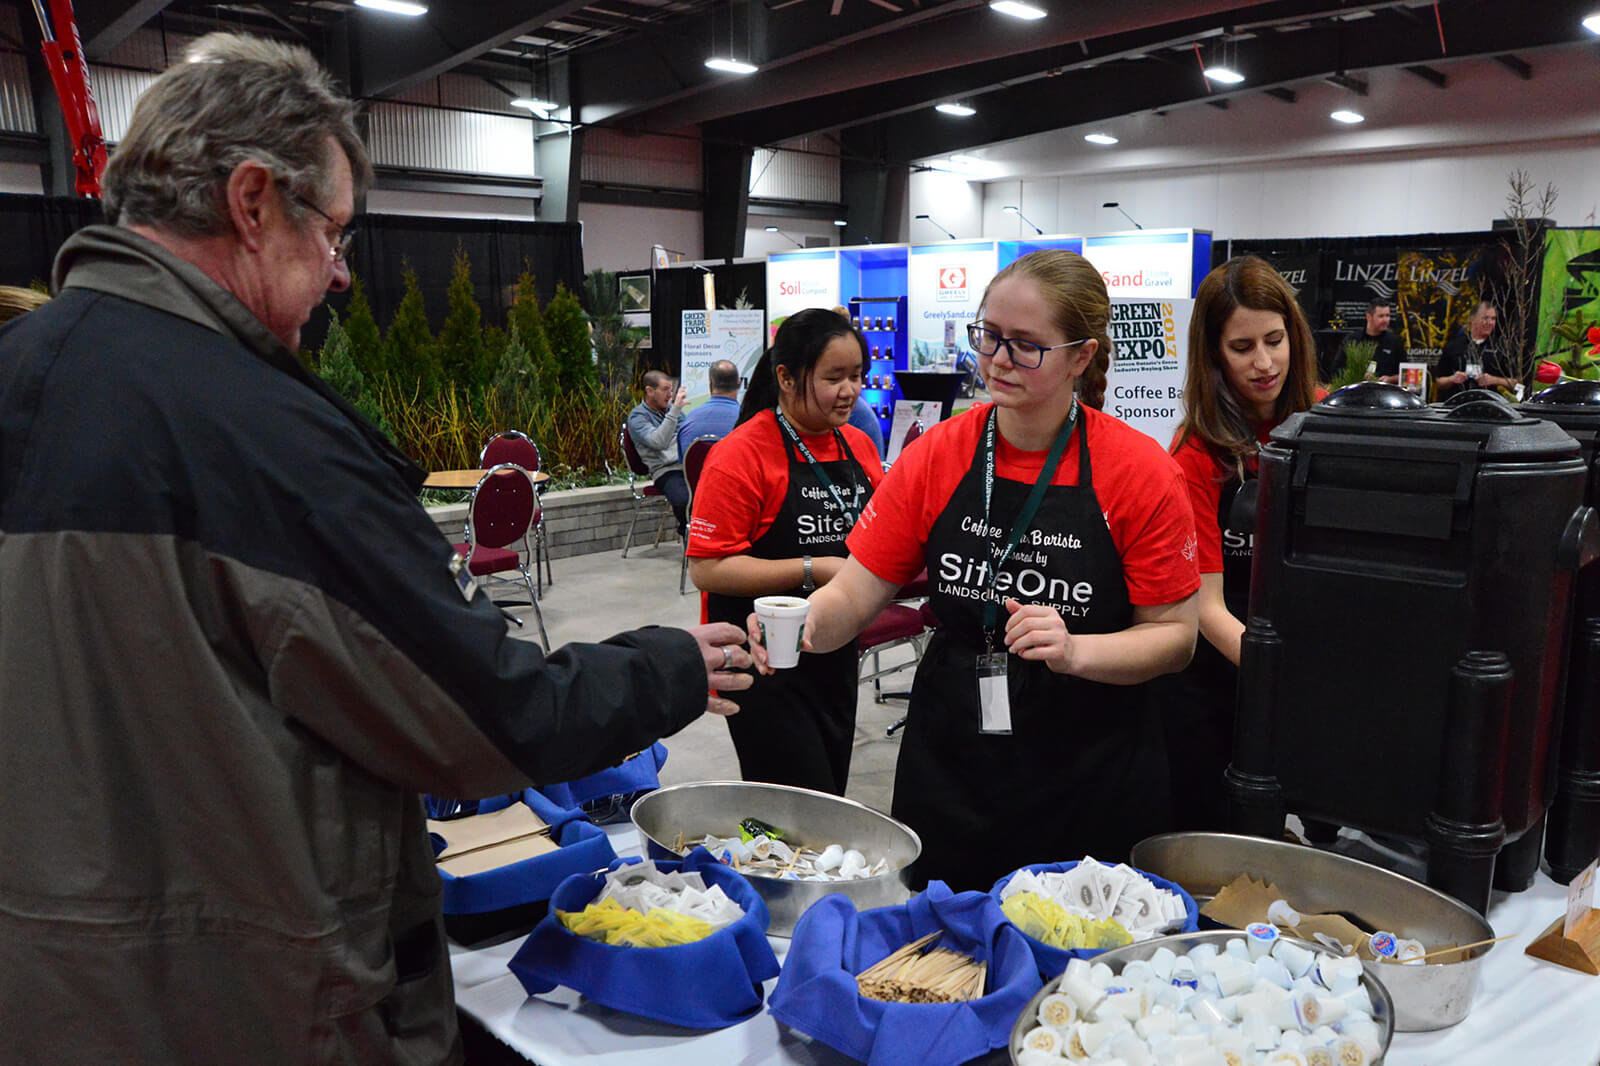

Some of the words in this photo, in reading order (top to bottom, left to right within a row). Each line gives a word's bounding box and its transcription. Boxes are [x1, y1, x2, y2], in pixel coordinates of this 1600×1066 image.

[1102, 270, 1143, 287] Sand
[1280, 270, 1307, 284] ZEL
[1410, 265, 1468, 282] LINZEL
[780, 281, 801, 296] Soil
[1145, 278, 1172, 287] Gravel
[923, 311, 977, 320] GreelySand.co
[1110, 303, 1161, 321] GREEN
[684, 327, 706, 335] EXPO
[1110, 321, 1164, 339] TRADE
[1162, 302, 1177, 358] 2017
[1112, 339, 1166, 360] EXPO
[1114, 385, 1163, 399] Coffee
[1168, 386, 1184, 399] Ba
[1114, 404, 1176, 420] Sponsor
[801, 486, 829, 500] Coffee
[961, 516, 1003, 538] Coffee
[1031, 529, 1082, 549] Barista
[1035, 551, 1048, 567] by
[939, 552, 1094, 603] SiteOne
